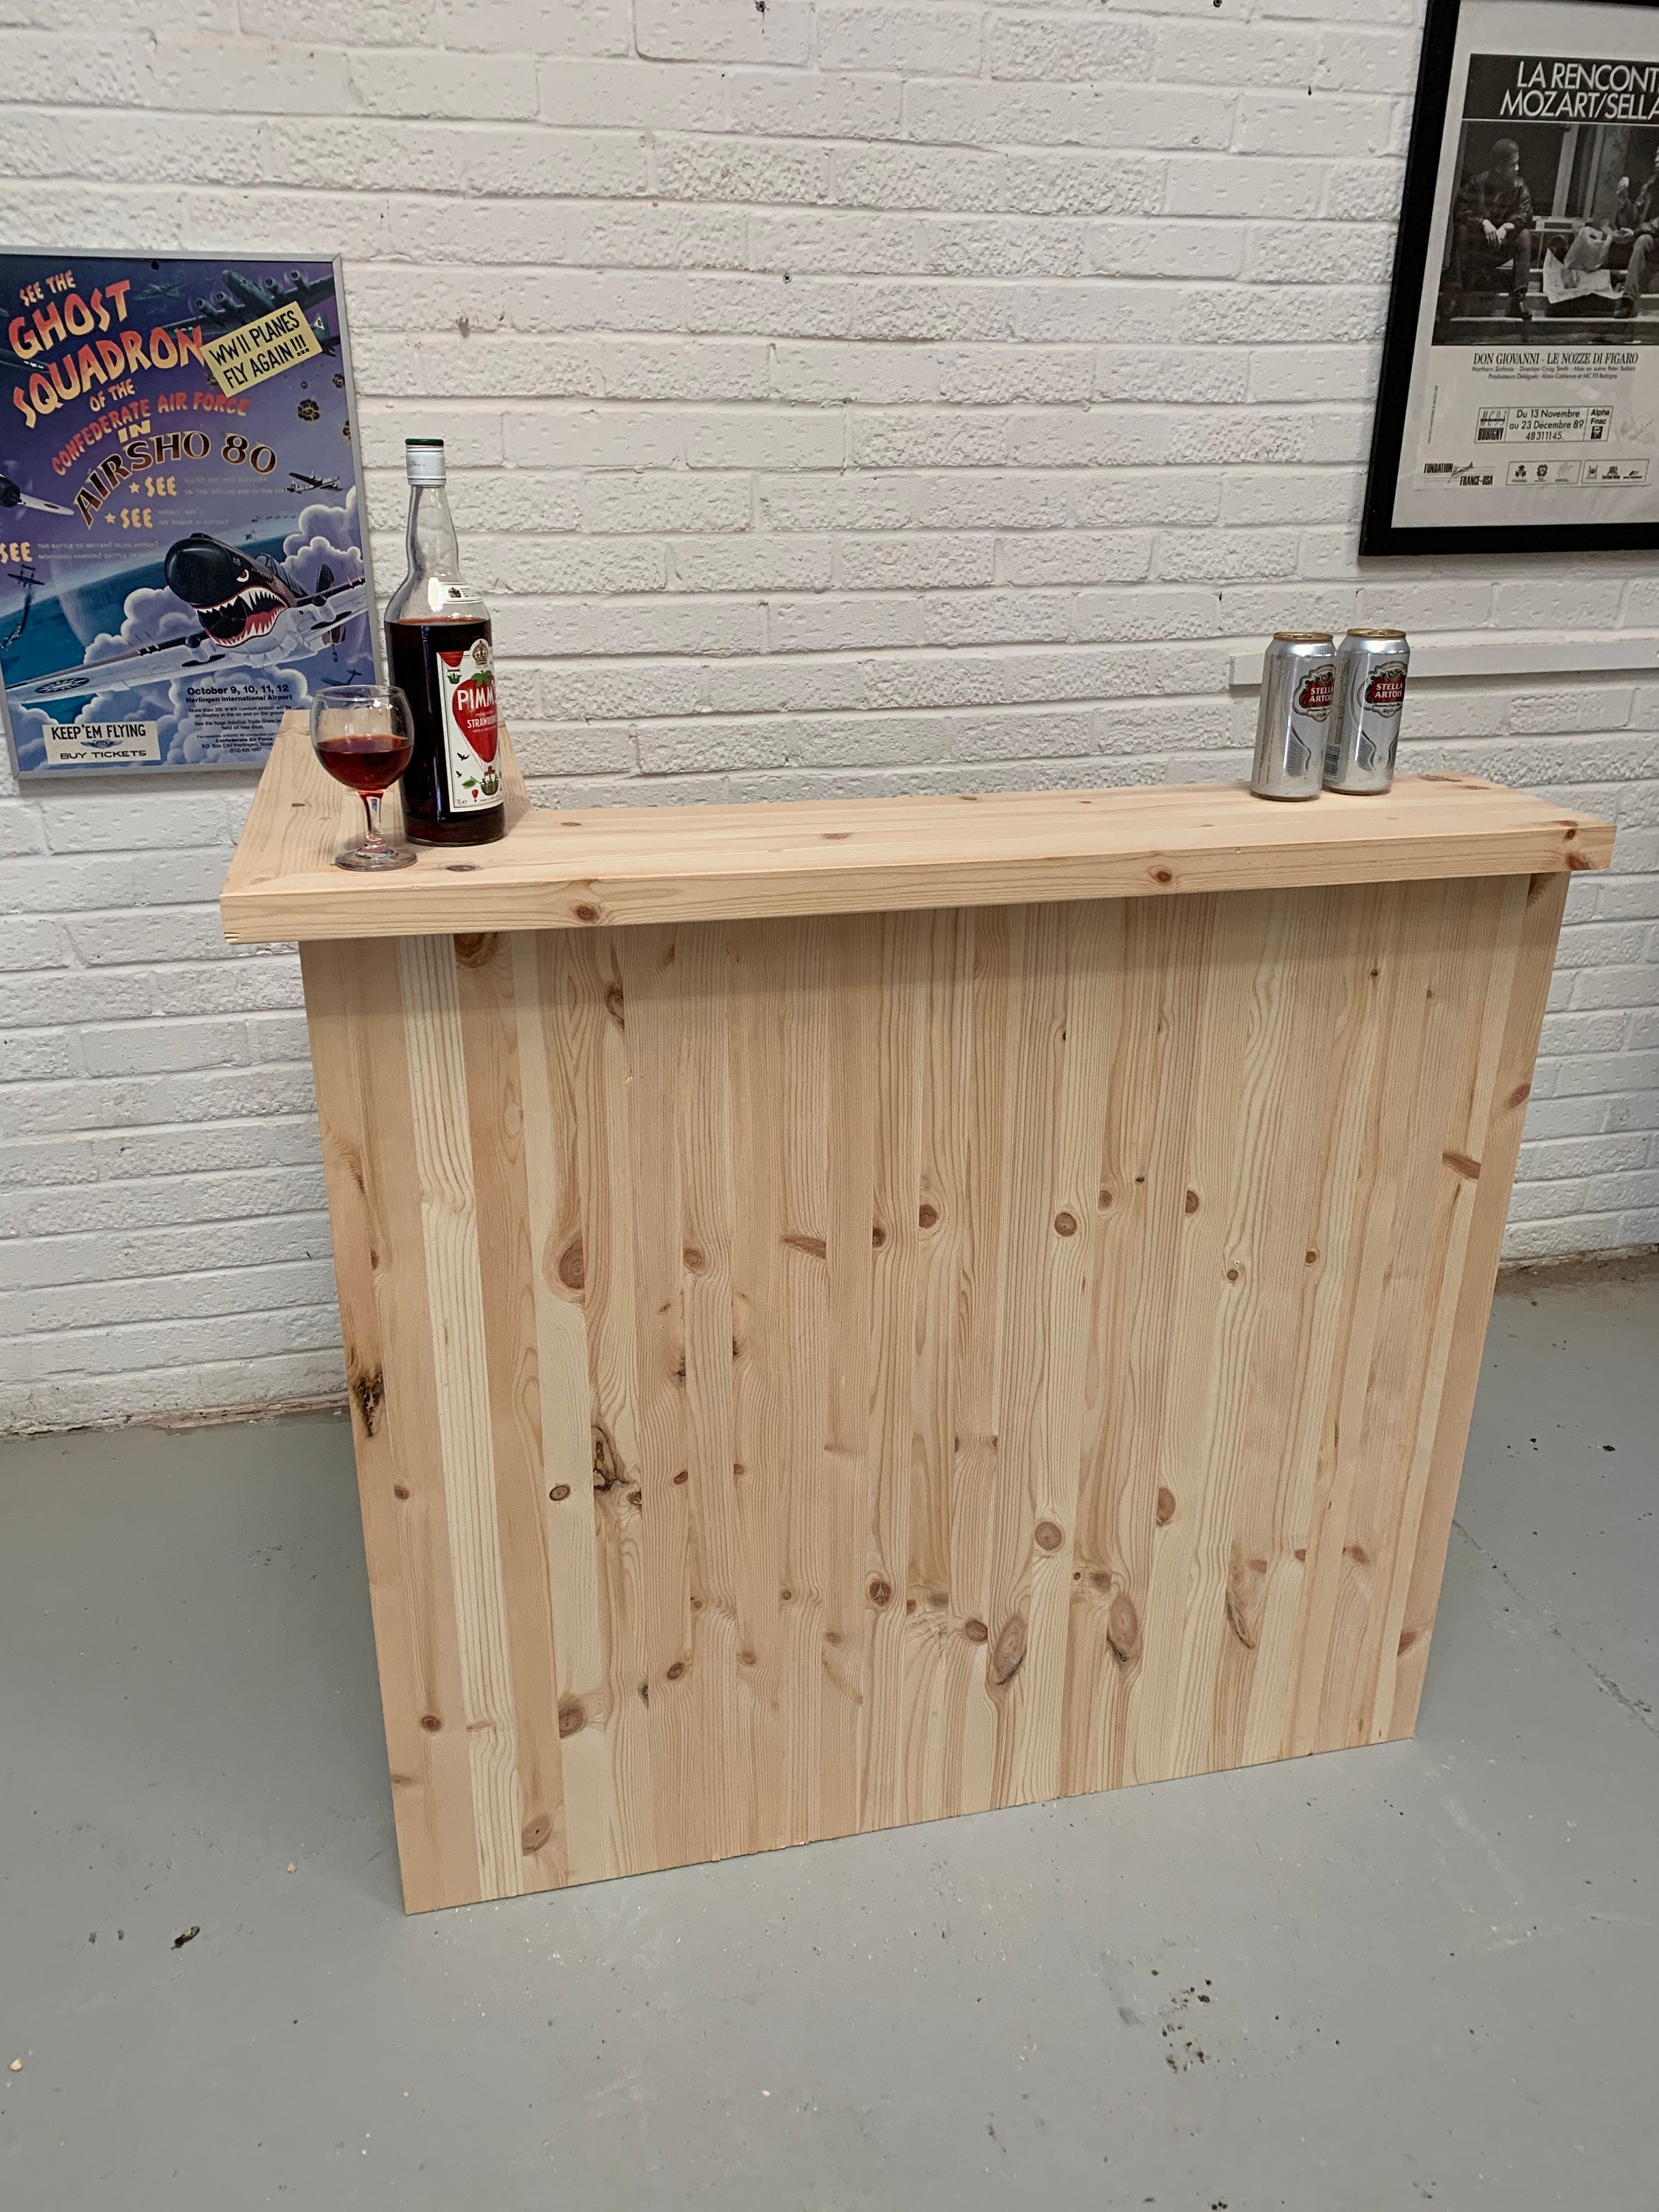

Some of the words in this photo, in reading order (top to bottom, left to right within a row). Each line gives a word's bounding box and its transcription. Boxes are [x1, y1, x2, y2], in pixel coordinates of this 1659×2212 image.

[1517, 61, 1546, 88] LA
[1551, 63, 1659, 93] RENCONT
[19, 282, 44, 307] SEE
[46, 270, 76, 293] THE
[8, 279, 131, 360] GHOST
[209, 334, 251, 366] WWII
[249, 310, 300, 347] PLANES
[1473, 352, 1494, 364] DON
[1496, 352, 1540, 364] GIOVANNI
[1547, 352, 1559, 364] LE
[1562, 352, 1591, 364] NOZZE
[1593, 352, 1603, 364] DI
[1604, 352, 1638, 364] FIGARO
[13, 324, 205, 429] SQUADRON
[223, 362, 248, 389] FLY
[89, 392, 105, 411] OF
[108, 378, 135, 401] THE
[1516, 410, 1528, 418] Du
[1531, 409, 1539, 418] 13
[1540, 409, 1580, 418] Novembre
[1591, 408, 1610, 417] Alpha
[51, 399, 151, 476] CONFEDERATE
[157, 392, 188, 414] AIR
[192, 392, 251, 417] FORCE
[117, 420, 151, 443] IN
[1521, 420, 1531, 429] 23
[1534, 420, 1571, 430] Décembre
[1573, 420, 1584, 428] 89
[1424, 462, 1453, 474] FONDATION
[74, 431, 211, 530] AIRSHO
[221, 433, 277, 474] 80
[145, 476, 177, 498] SEE
[1459, 475, 1493, 486] FRANCE-USA
[120, 507, 153, 529] SEE
[0, 541, 32, 564] SEE
[187, 686, 228, 695] October
[230, 686, 240, 695] 9,
[243, 685, 258, 695] 10,
[261, 684, 274, 694] 11,
[277, 684, 289, 692] 12
[1374, 690, 1402, 698] ARTOIS
[1376, 682, 1402, 691] STELLA
[268, 694, 293, 702] Airport
[51, 726, 81, 740] KEEP
[107, 724, 146, 738] FLYING
